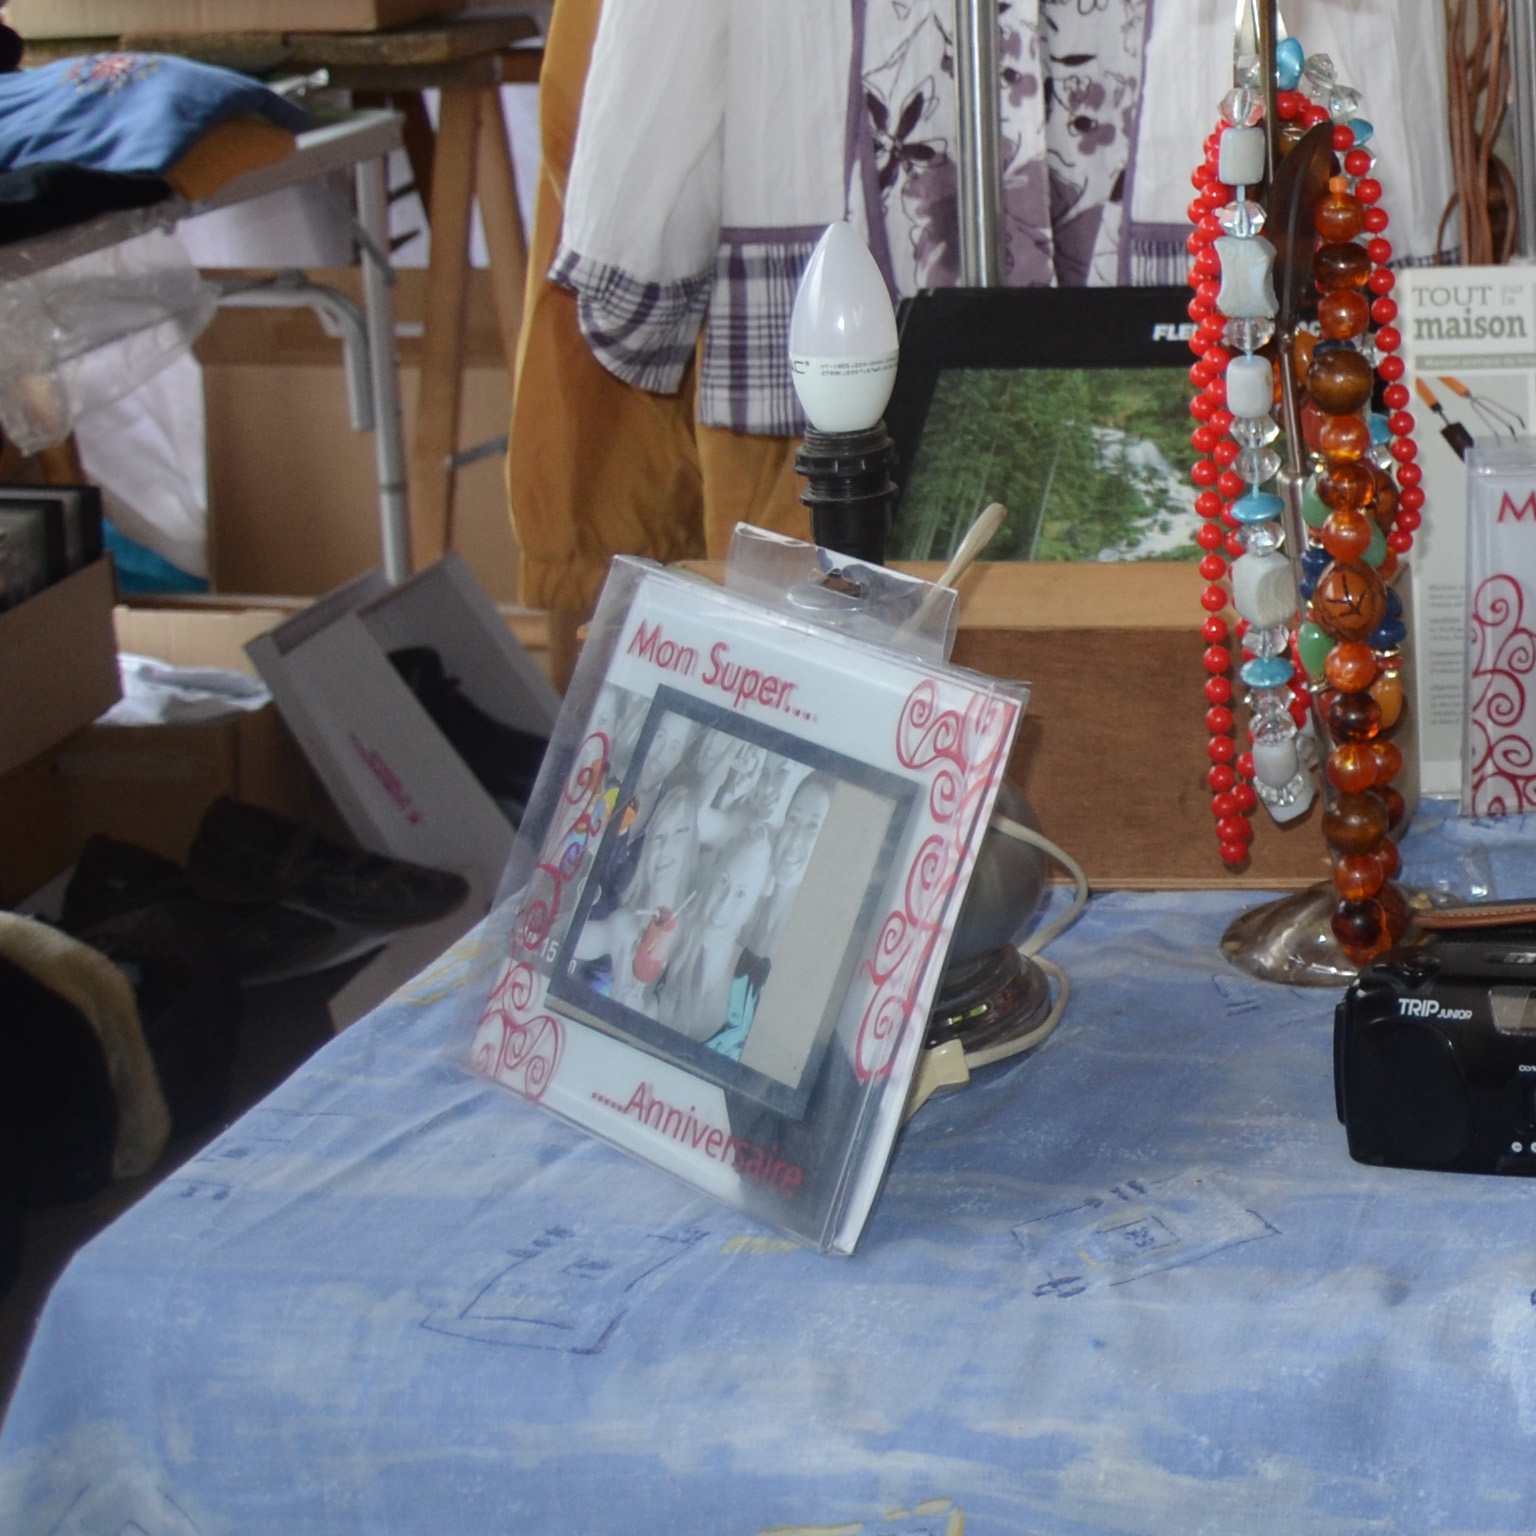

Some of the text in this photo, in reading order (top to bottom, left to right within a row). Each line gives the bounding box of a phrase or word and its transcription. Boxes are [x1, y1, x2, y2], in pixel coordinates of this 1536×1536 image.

[1412, 286, 1492, 308] TOUT
[1153, 322, 1199, 342] FLE
[1414, 308, 1527, 341] maison
[626, 618, 700, 676] Mon
[540, 937, 560, 962] 15
[1398, 998, 1474, 1021] TRIP JUNIOR
